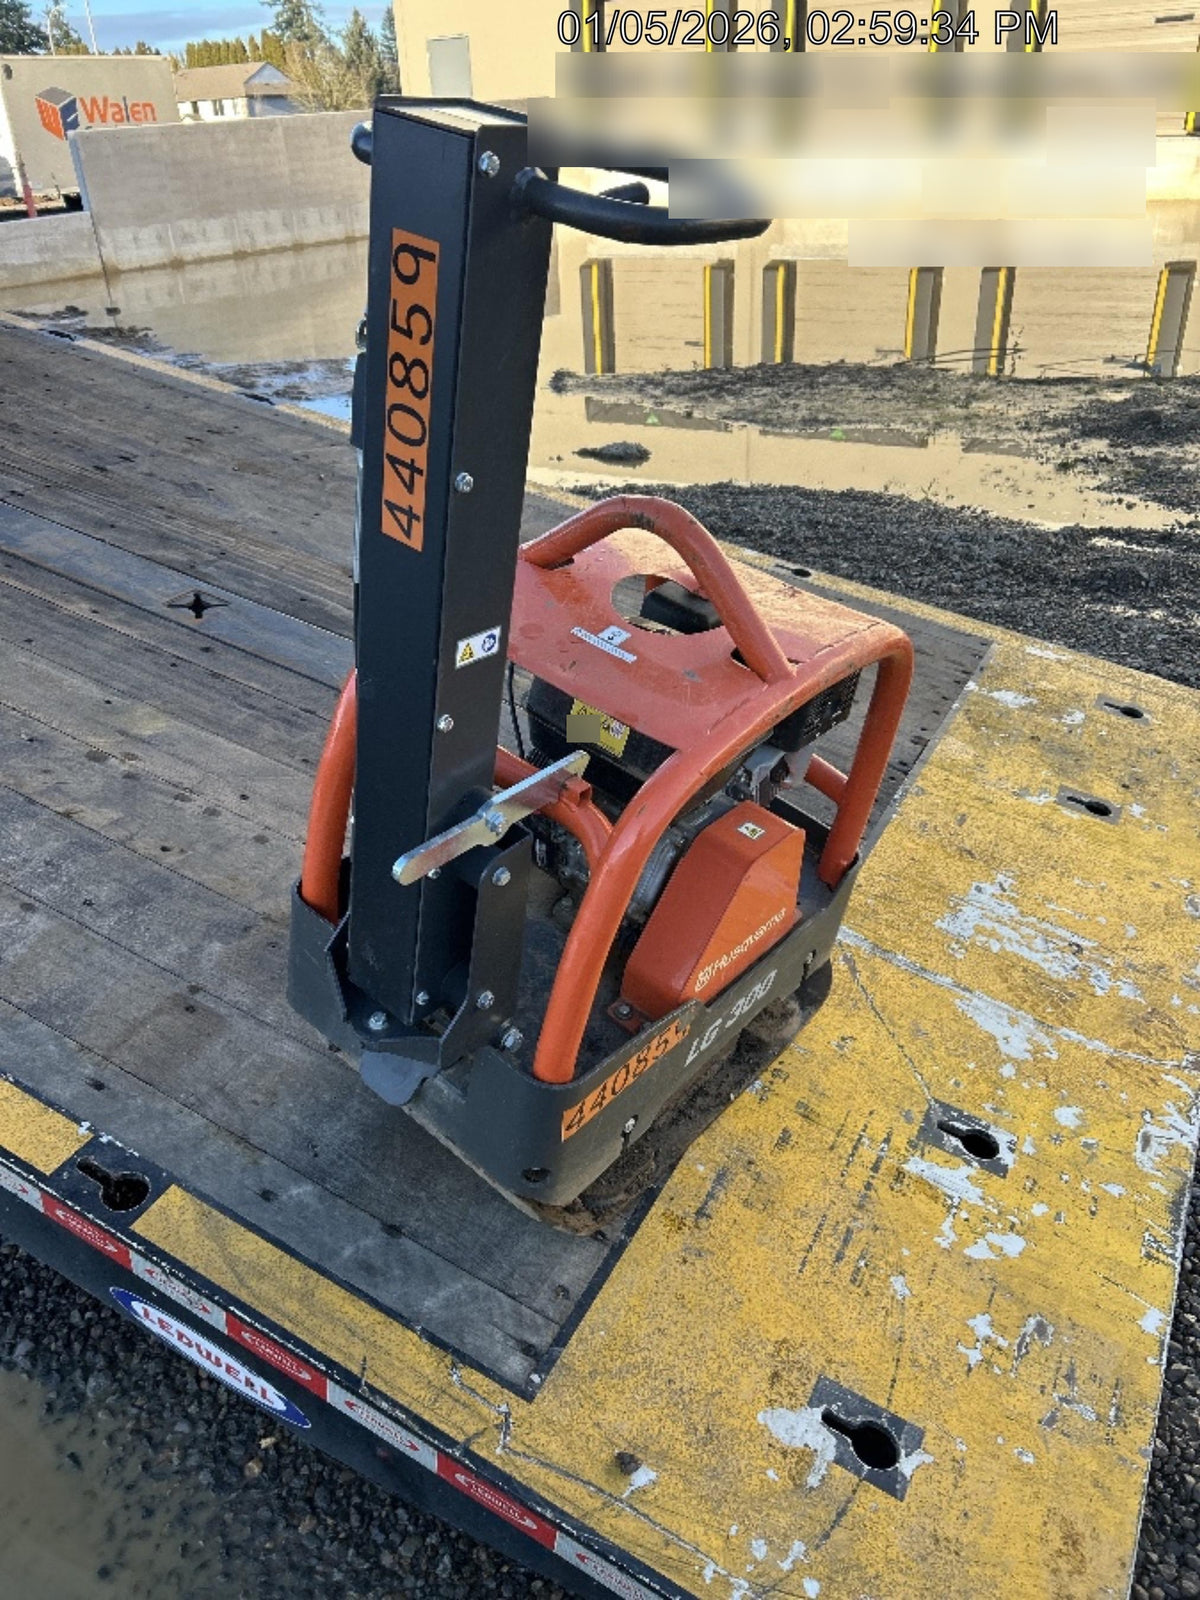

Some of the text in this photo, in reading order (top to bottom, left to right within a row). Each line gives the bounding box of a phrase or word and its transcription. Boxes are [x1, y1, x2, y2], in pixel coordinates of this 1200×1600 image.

[79, 96, 157, 123] Walen
[384, 242, 436, 540] 440859
[685, 969, 778, 1067] LG 300
[141, 1305, 275, 1405] LEDWELL
